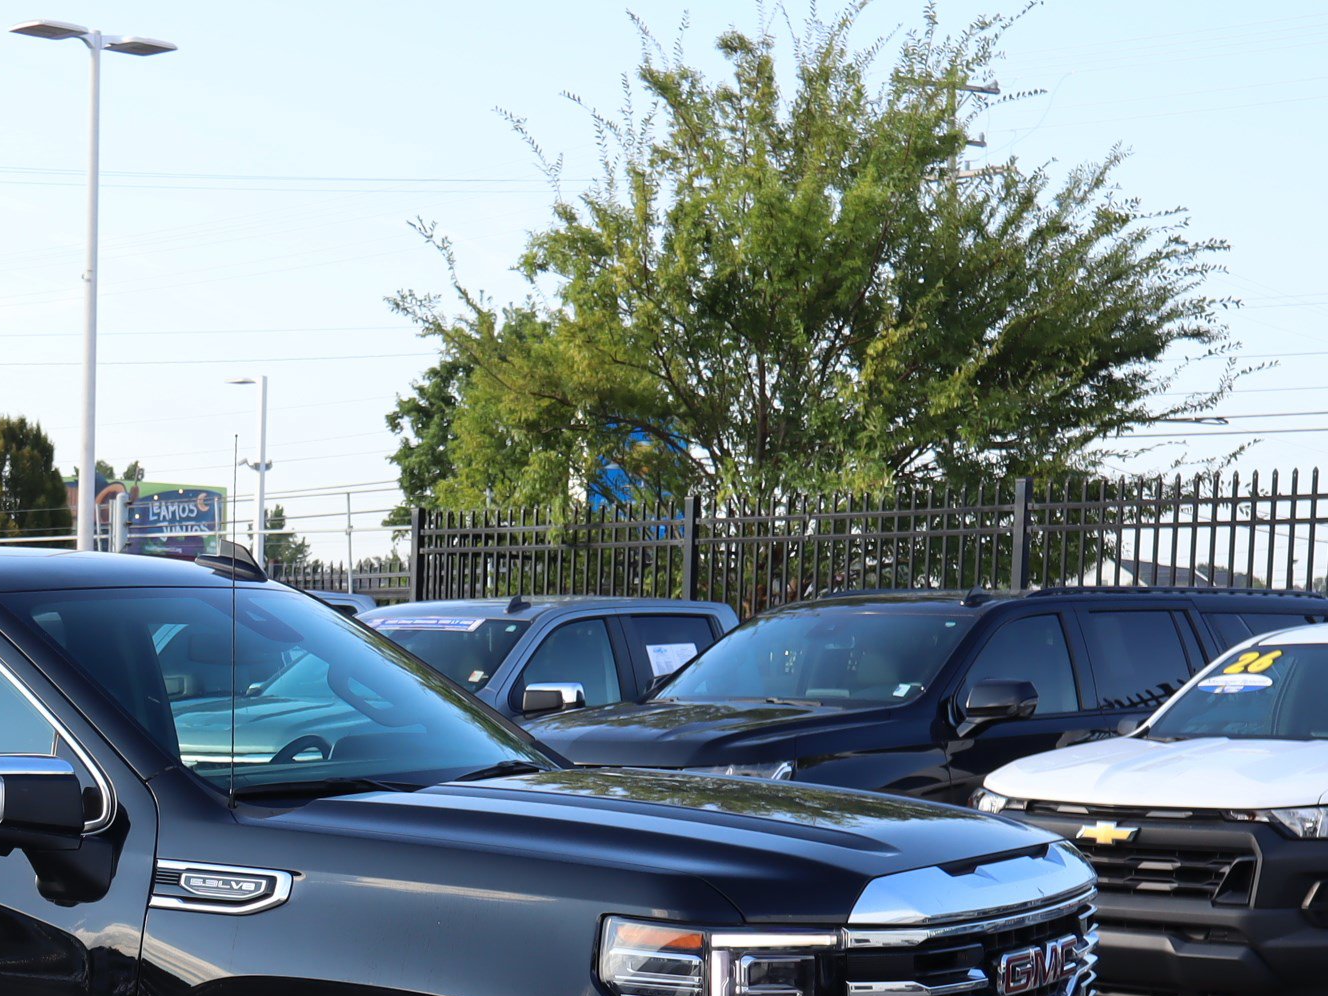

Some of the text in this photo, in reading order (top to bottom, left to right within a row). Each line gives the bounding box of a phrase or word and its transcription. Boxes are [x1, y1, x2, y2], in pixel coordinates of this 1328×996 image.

[149, 502, 198, 520] LEAMOS
[1223, 650, 1282, 674] 26
[997, 934, 1077, 996] GMC
